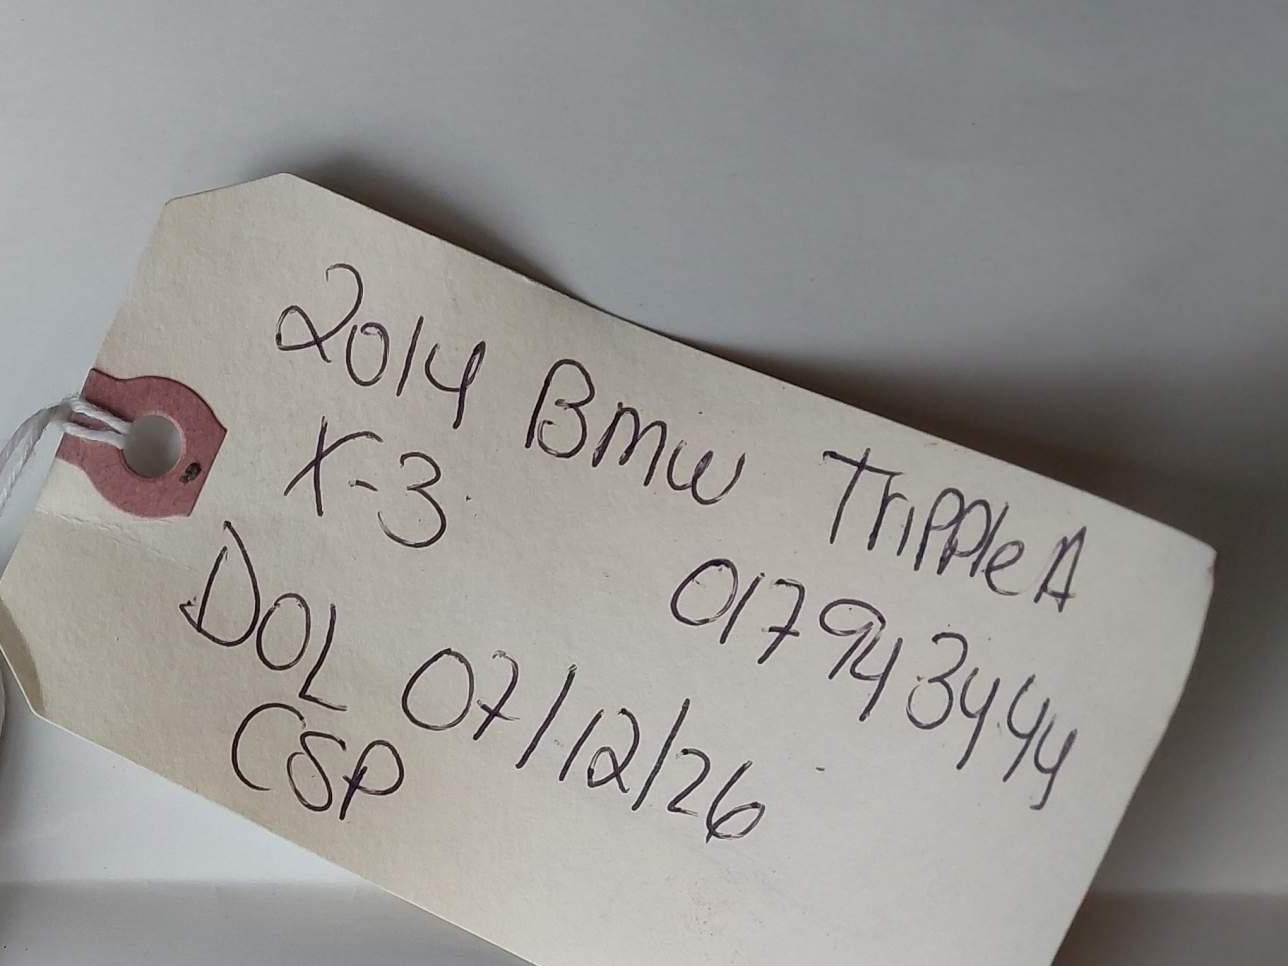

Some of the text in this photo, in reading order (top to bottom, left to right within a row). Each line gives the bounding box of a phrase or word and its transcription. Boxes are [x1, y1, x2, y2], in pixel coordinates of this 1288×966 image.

[274, 261, 488, 431] 2014
[179, 519, 767, 844] DOL 07/12/26
